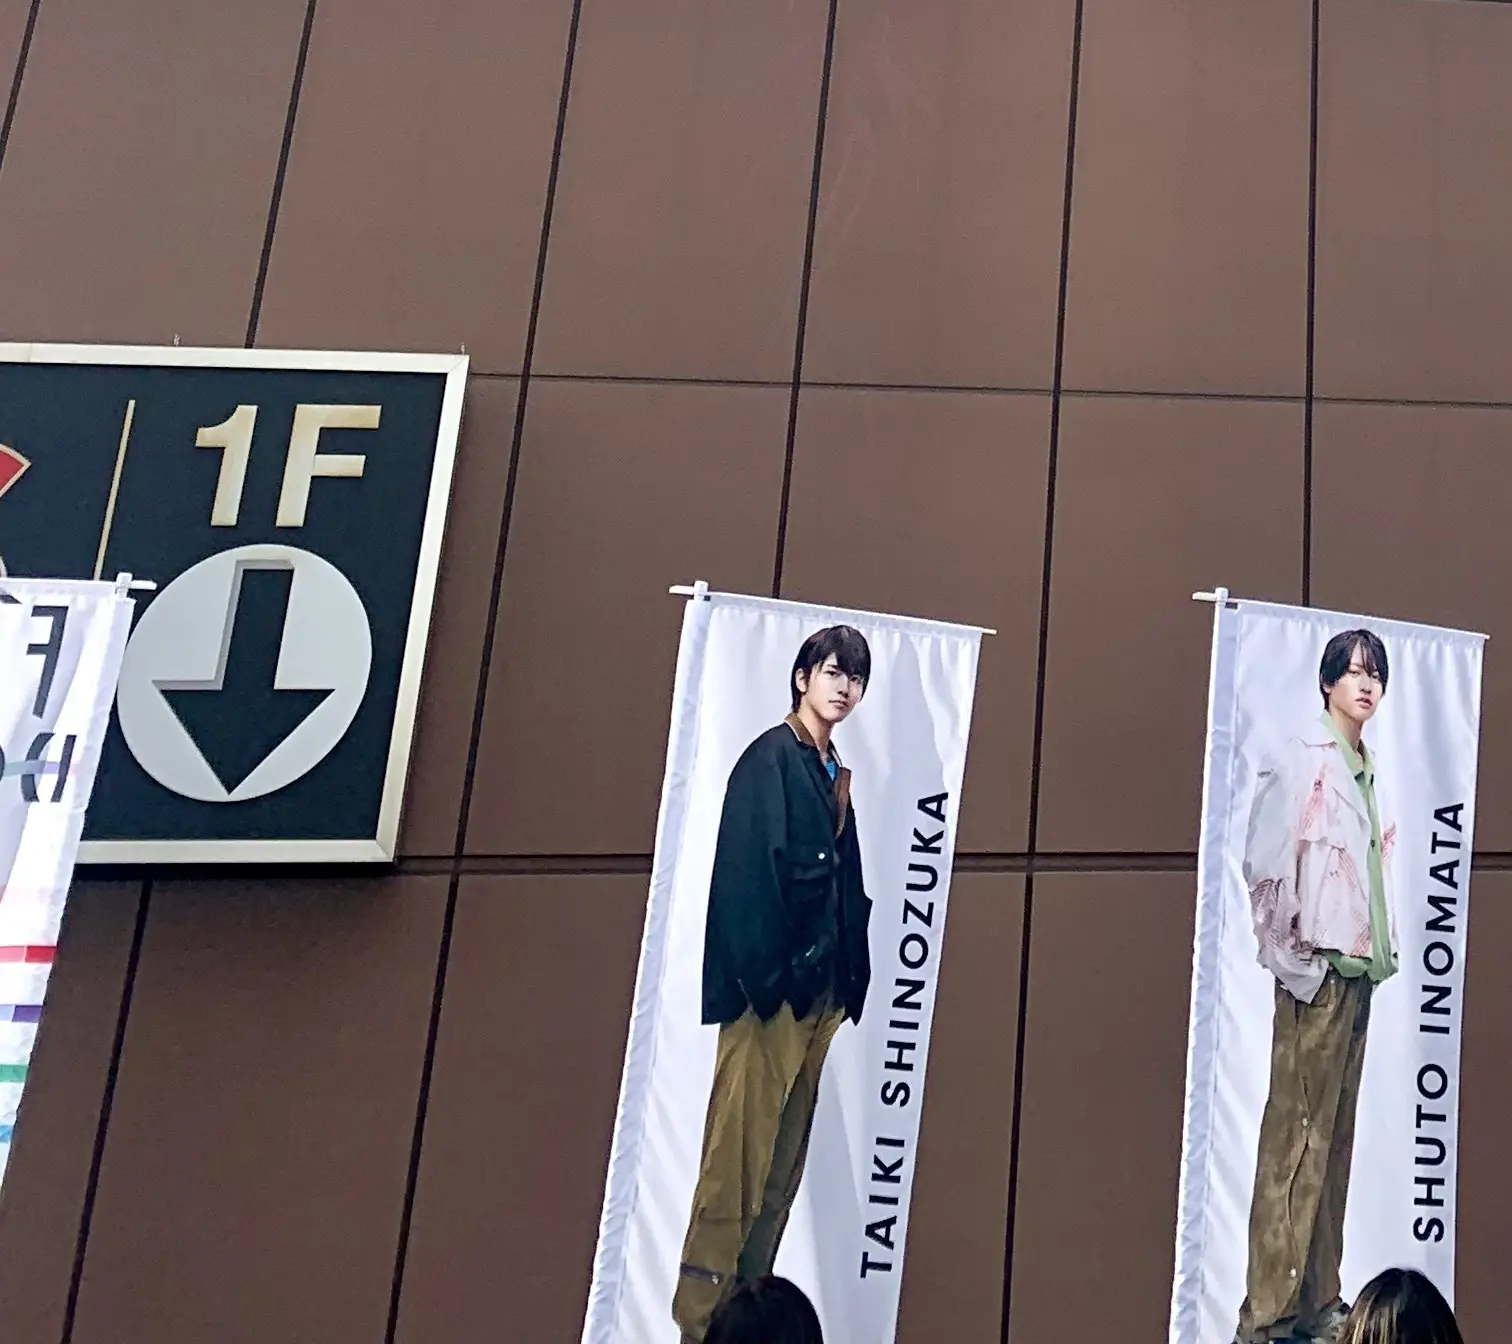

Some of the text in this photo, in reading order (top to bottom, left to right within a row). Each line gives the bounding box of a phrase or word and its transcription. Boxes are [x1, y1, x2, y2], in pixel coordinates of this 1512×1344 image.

[194, 404, 383, 528] 1F
[859, 790, 950, 1280] TAIKI SHINOZUKA
[1412, 801, 1465, 1243] SHUTO INOMATA
